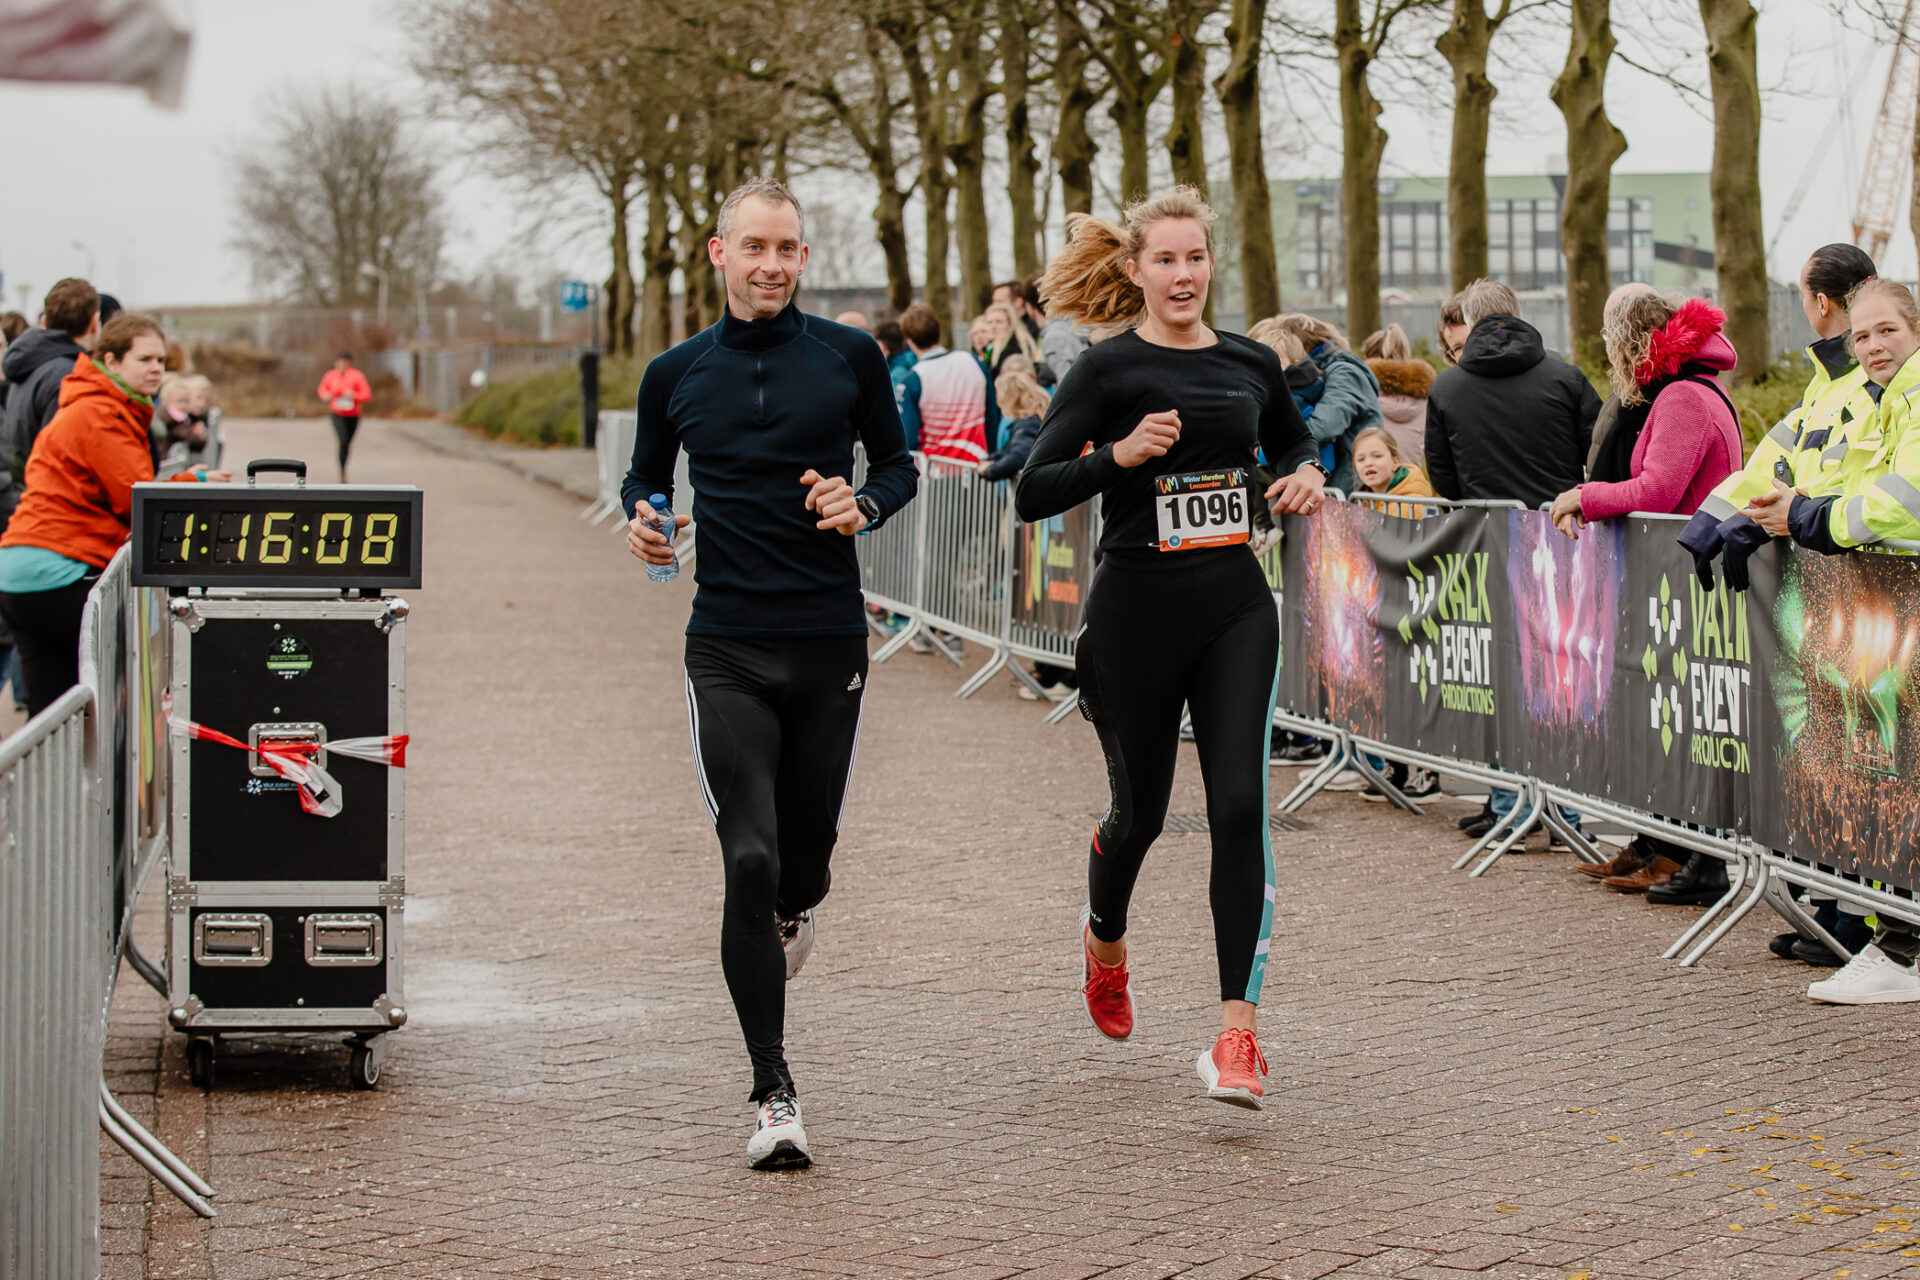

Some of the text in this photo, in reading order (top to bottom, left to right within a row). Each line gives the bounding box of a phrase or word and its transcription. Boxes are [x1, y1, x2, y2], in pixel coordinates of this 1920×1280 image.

[1165, 491, 1242, 529] 1096
[181, 512, 398, 564] 1:16:08
[1441, 625, 1492, 685] EVENT
